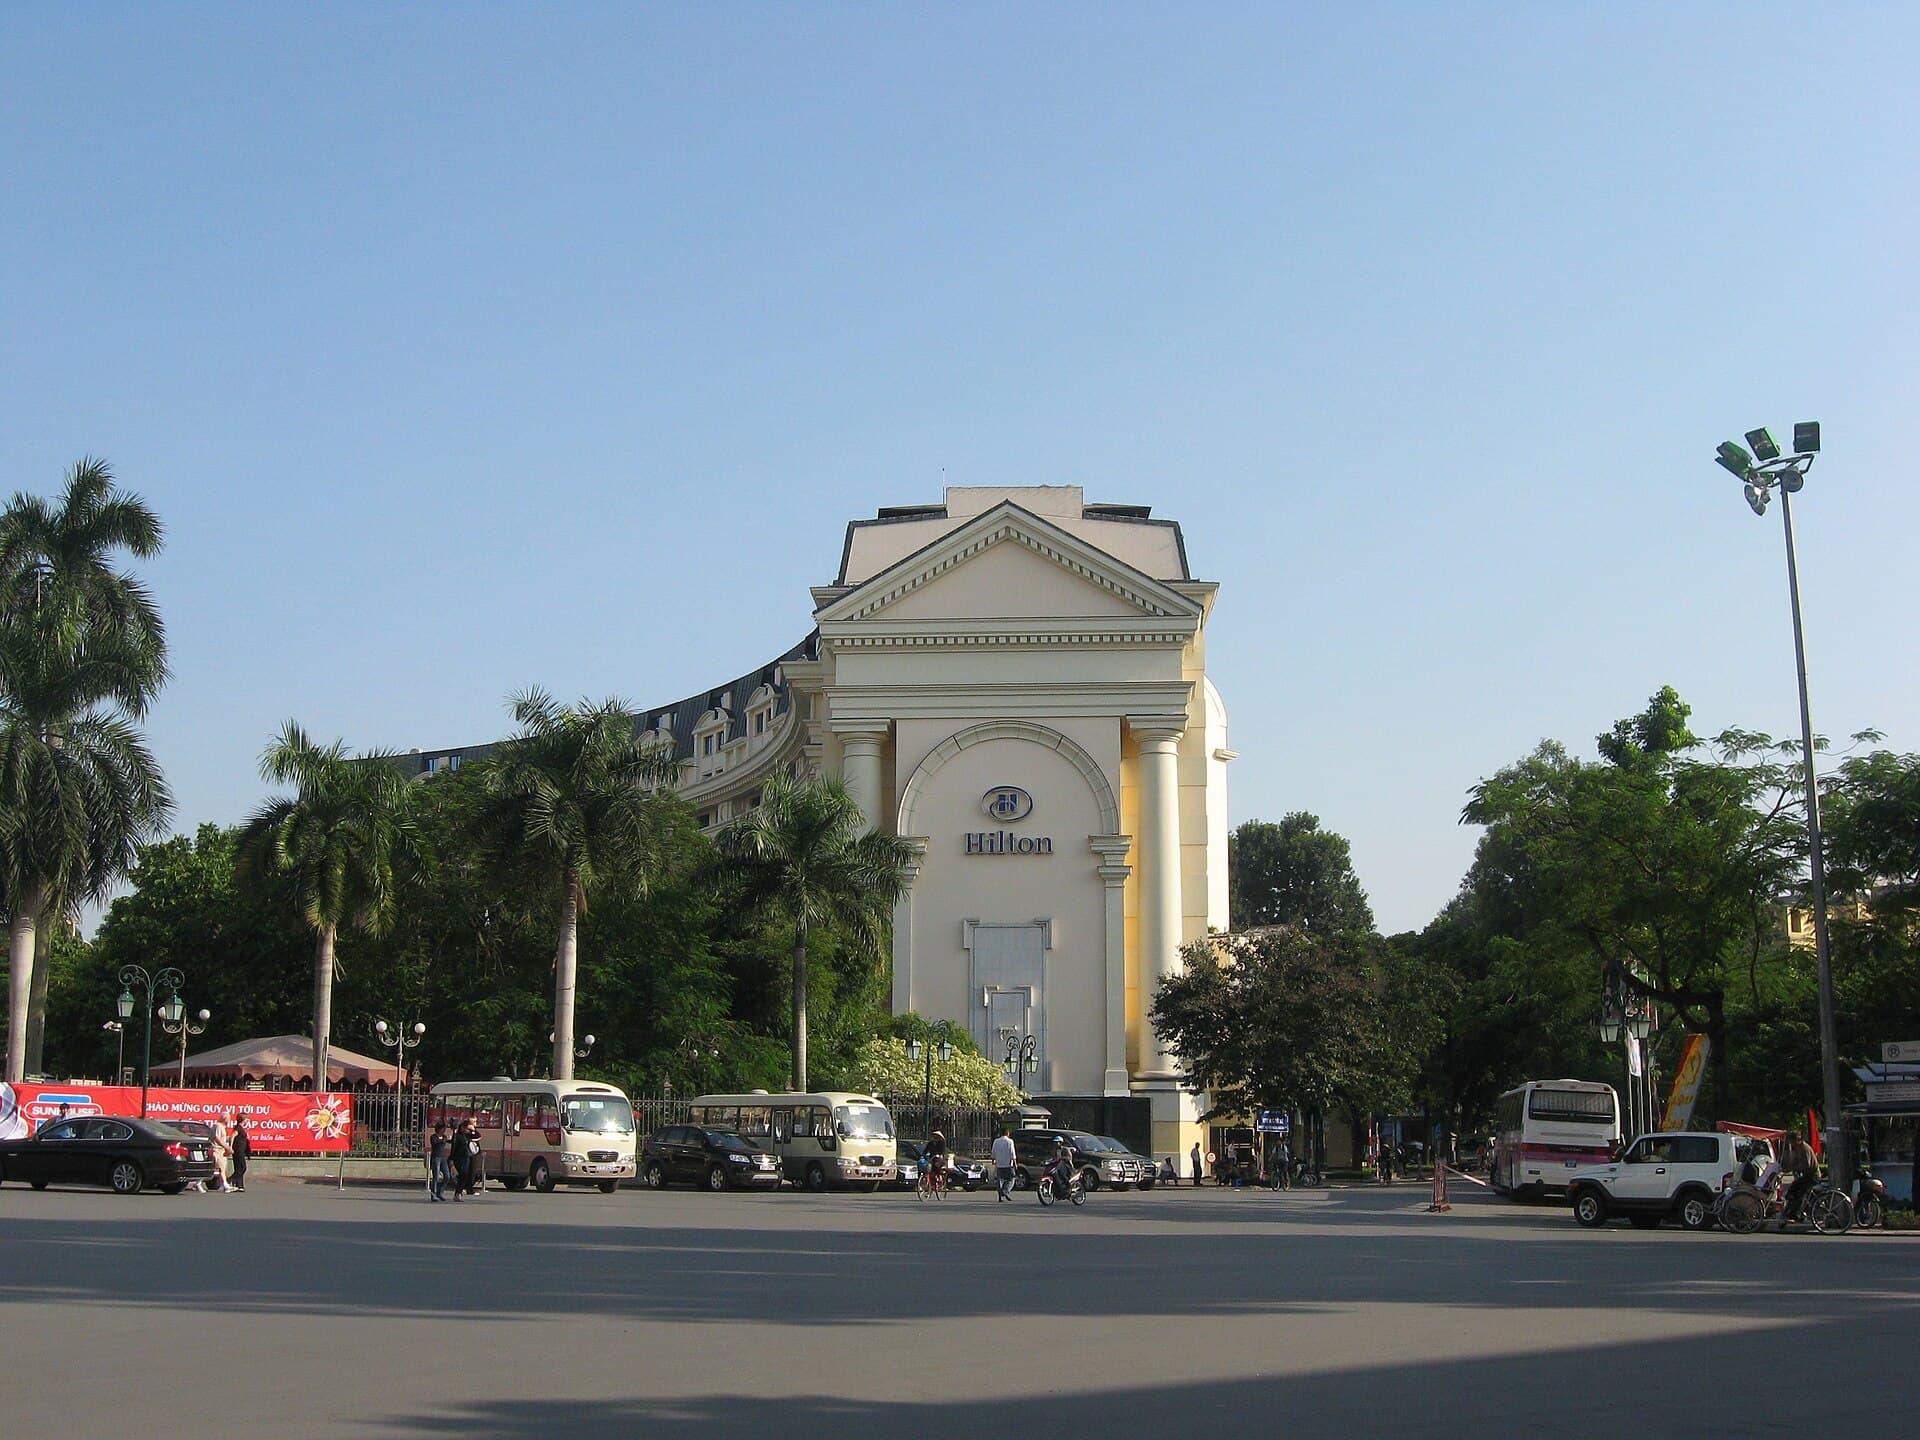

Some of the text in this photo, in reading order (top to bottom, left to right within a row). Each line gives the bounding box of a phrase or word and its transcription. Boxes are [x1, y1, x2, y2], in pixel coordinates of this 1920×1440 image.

[965, 831, 1053, 854] Hilton
[202, 1103, 223, 1114] QUÝ
[238, 1104, 254, 1114] TỚI
[256, 1104, 271, 1115] DỰ
[260, 1118, 288, 1129] CÔNG
[289, 1121, 302, 1129] TY
